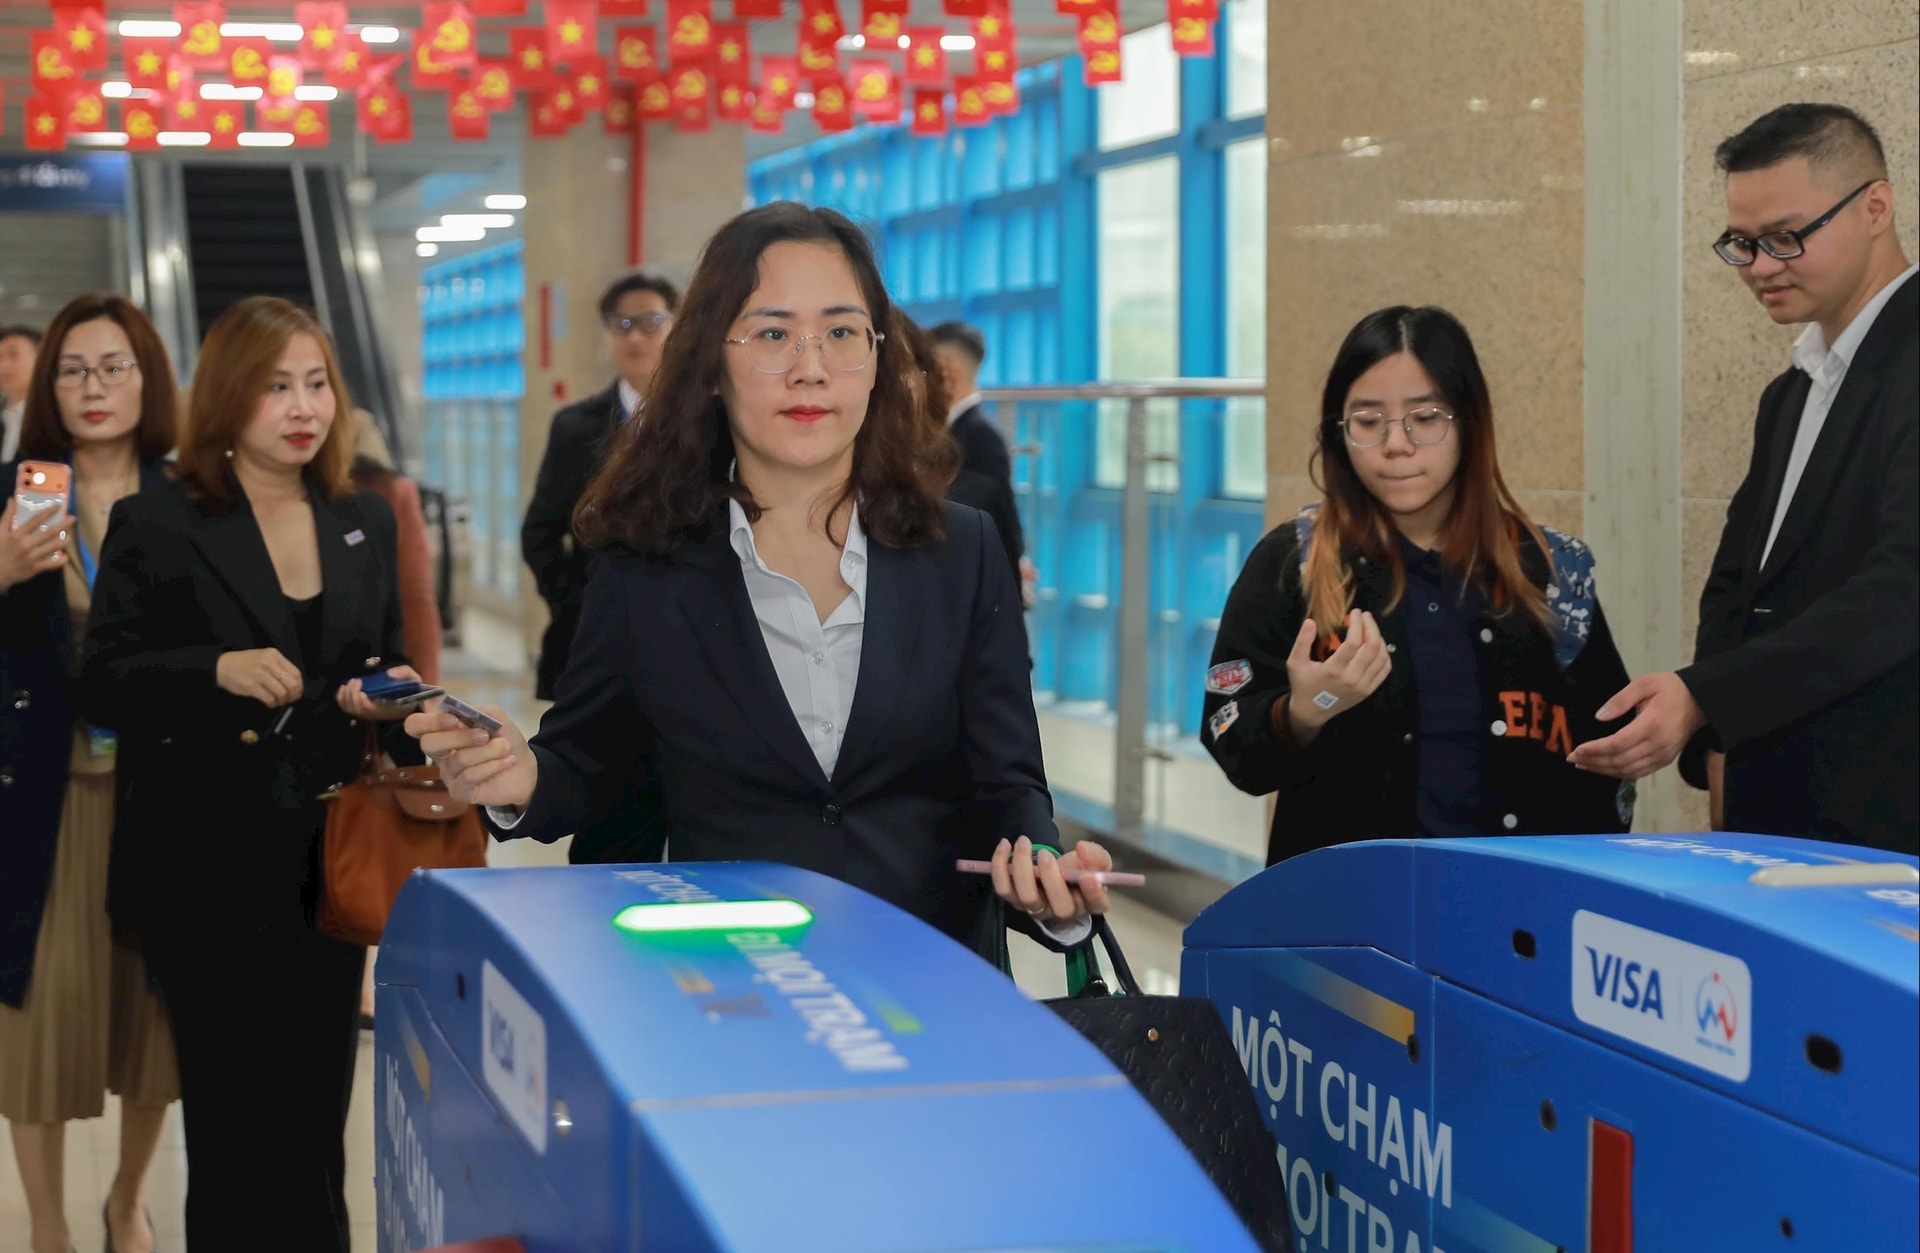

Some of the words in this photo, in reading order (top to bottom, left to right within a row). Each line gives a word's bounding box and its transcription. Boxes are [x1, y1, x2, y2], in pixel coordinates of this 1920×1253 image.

[1584, 945, 1664, 1020] VISA
[791, 990, 910, 1072] TRẠM
[1232, 1005, 1313, 1120] MỘT
[1320, 1060, 1453, 1209] CHẠM
[1276, 1143, 1334, 1253] ỌI
